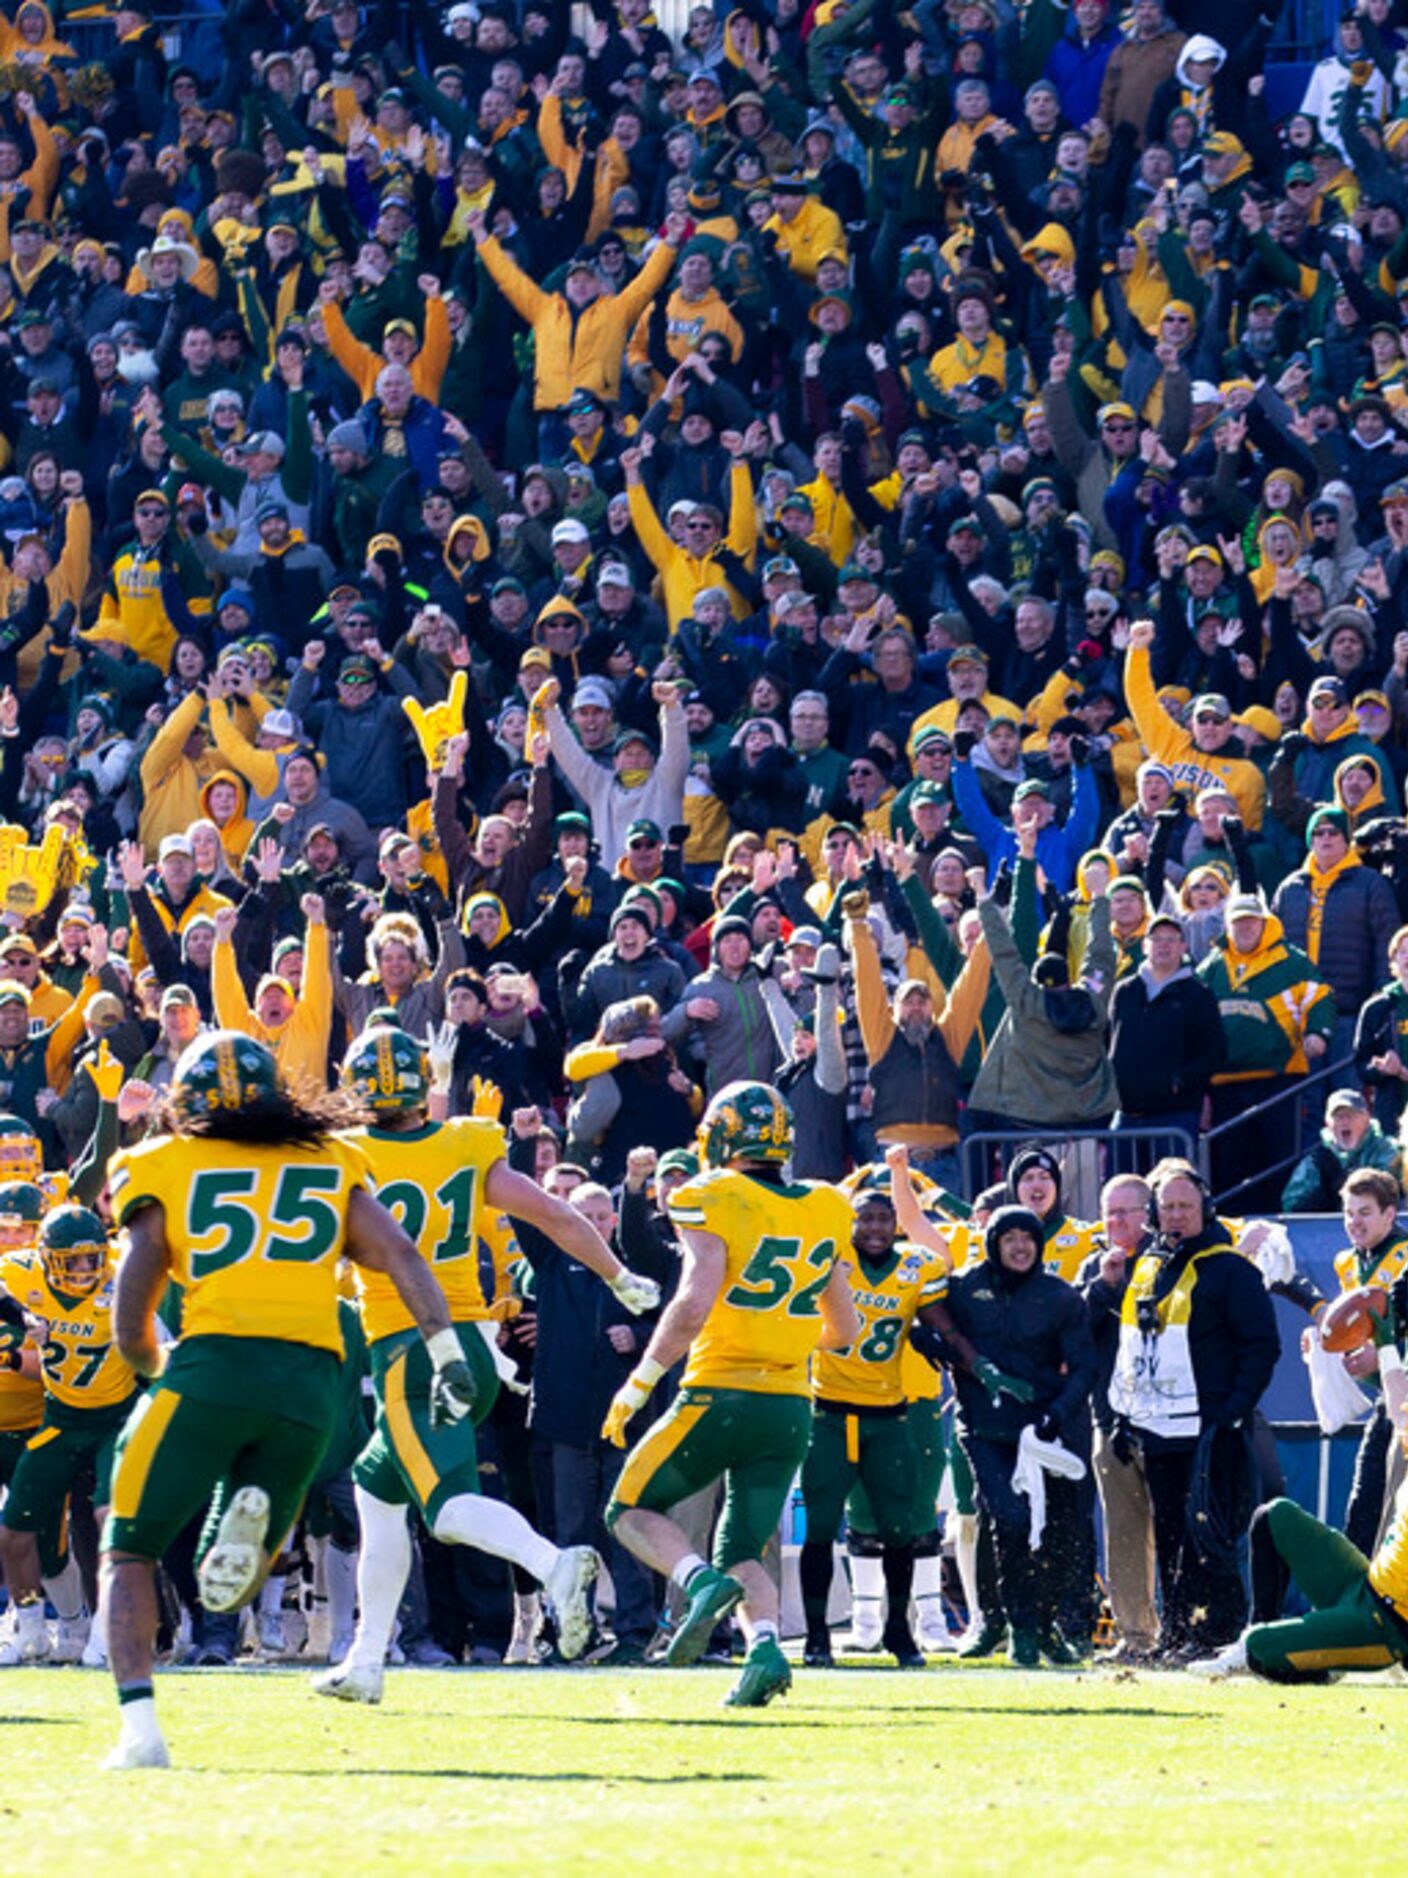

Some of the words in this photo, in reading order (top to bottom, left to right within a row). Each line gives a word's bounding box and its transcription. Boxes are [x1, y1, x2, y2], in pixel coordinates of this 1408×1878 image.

[187, 1165, 343, 1282] 55
[723, 1234, 836, 1318] 52
[40, 1341, 112, 1389] 27
